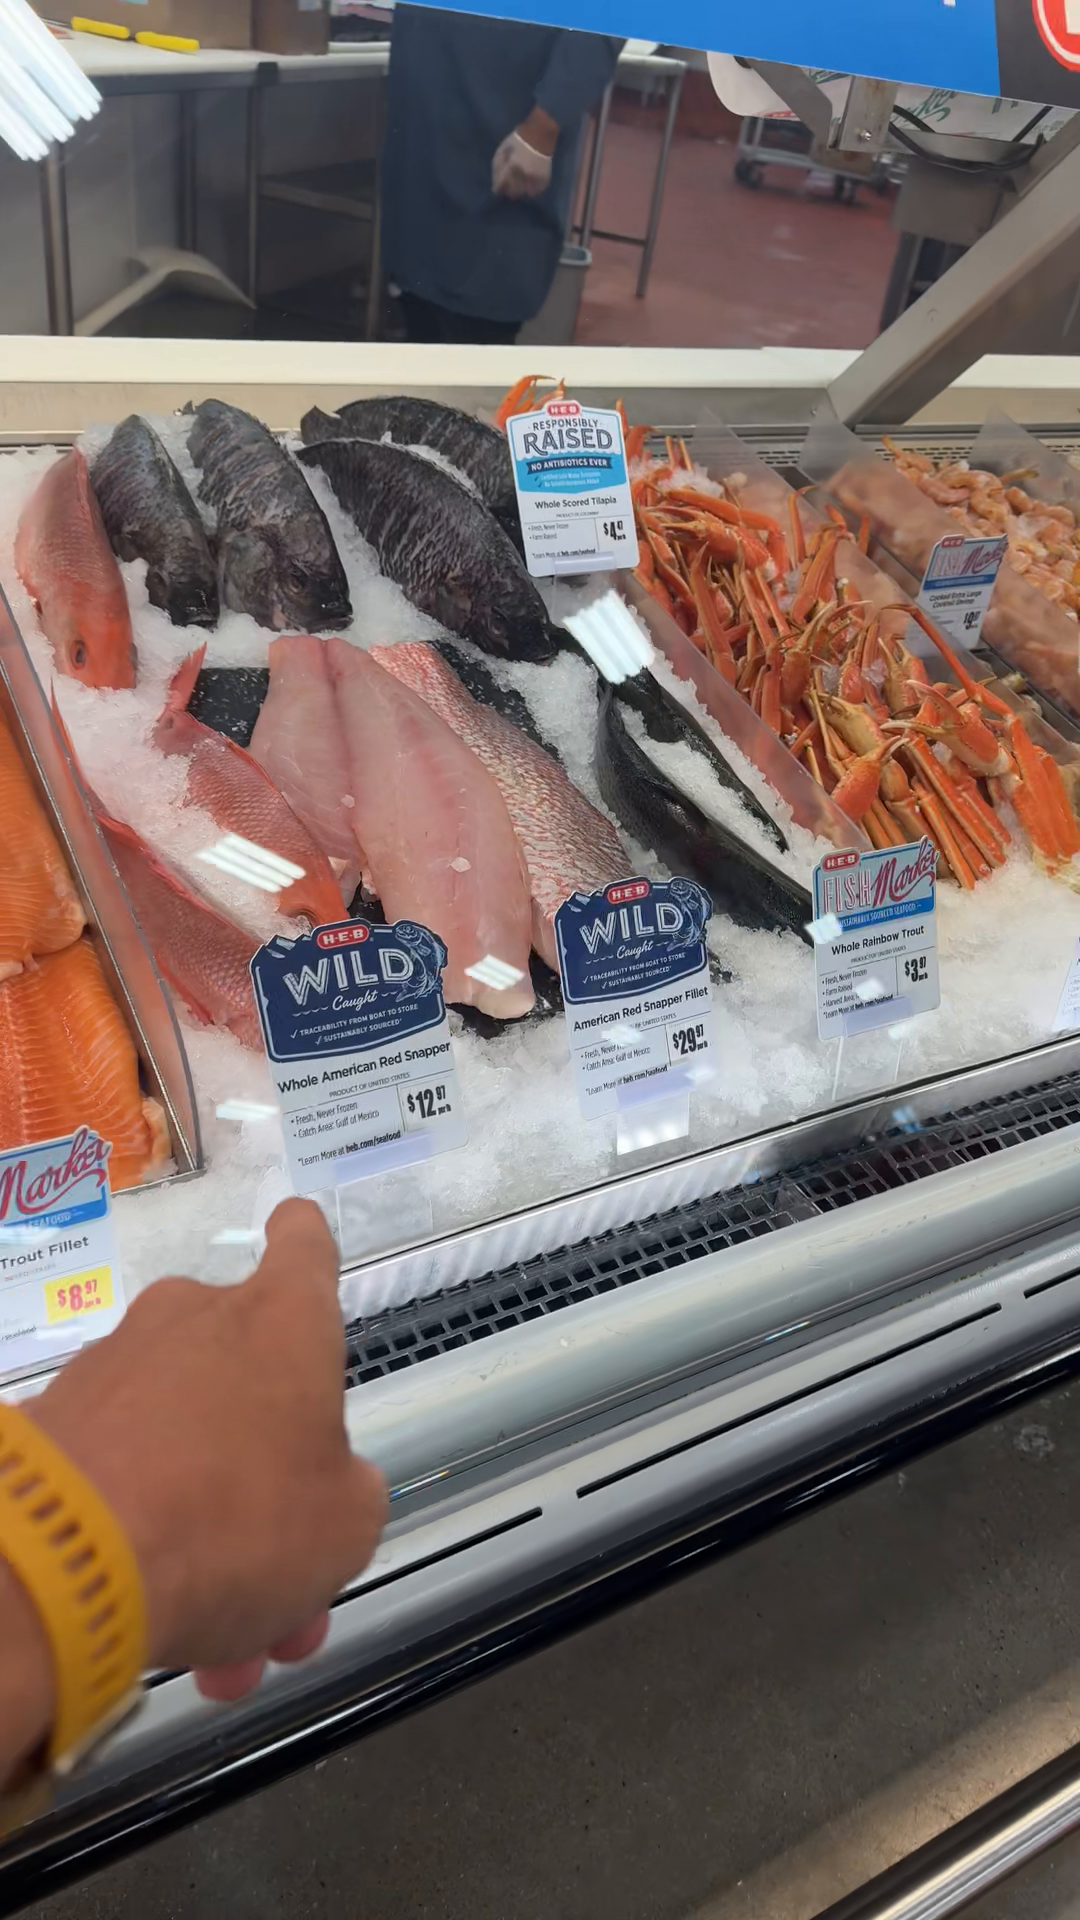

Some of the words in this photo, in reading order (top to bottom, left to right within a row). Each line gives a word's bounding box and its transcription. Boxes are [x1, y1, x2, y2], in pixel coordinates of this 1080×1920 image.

[533, 419, 598, 431] RESPONSIBLY
[524, 428, 612, 456] RAISED
[531, 463, 542, 471] NO
[543, 458, 588, 469] ANTIBIOTICS
[589, 458, 608, 466] EVER
[535, 500, 560, 509] Whole
[562, 498, 590, 507] Scored
[591, 496, 617, 505] Tilapia
[824, 870, 871, 914] FISH
[871, 839, 938, 908] Market
[579, 903, 684, 954] WILD
[832, 942, 860, 955] Whole
[862, 932, 899, 948] Rainbow
[902, 926, 924, 938] Trout
[616, 941, 654, 960] Caught
[282, 948, 414, 1006] WILD
[589, 967, 628, 982] TRACEABILITY
[629, 963, 645, 972] FROM
[646, 960, 659, 968] BOAT
[668, 952, 686, 962] STORE
[826, 977, 839, 985] Fresh,
[839, 973, 852, 982] Never
[853, 969, 867, 978] Frozen
[608, 973, 644, 987] SUSTAINABLY
[826, 988, 837, 996] Farm
[838, 983, 853, 992] Raised
[332, 990, 379, 1011] Caught
[574, 1012, 620, 1032] American
[622, 1004, 642, 1019] Red
[644, 994, 682, 1012] Snapper
[685, 986, 708, 1001] Fillet
[826, 997, 843, 1007] Harvest
[300, 1020, 347, 1036] TRACEABILITY
[349, 1015, 368, 1026] FROM
[369, 1010, 386, 1021] BOAT
[388, 1008, 396, 1017] TO
[398, 1003, 418, 1015] STORE
[660, 1012, 676, 1022] STATES
[323, 1026, 368, 1043] SUSTAINABLY
[586, 1061, 601, 1072] Catch
[615, 1052, 626, 1063] Gulf
[633, 1047, 651, 1058] Mexico
[601, 1045, 616, 1054] Never
[278, 1074, 318, 1093] Whole
[321, 1060, 377, 1083] American
[379, 1053, 402, 1069] Red
[404, 1042, 451, 1062] Snapper
[329, 1085, 358, 1098] PRODUCT
[368, 1077, 389, 1089] UNITED
[390, 1072, 410, 1082] STATES
[603, 1079, 616, 1091] More
[296, 1112, 316, 1125] Fresh,
[316, 1108, 335, 1119] Never
[336, 1102, 358, 1114] Frozen
[298, 1126, 316, 1138] Catch
[335, 1117, 349, 1129] Gulf
[350, 1116, 356, 1124] of
[357, 1110, 380, 1122] Mexico
[320, 1148, 337, 1160] More
[338, 1147, 345, 1156] at
[345, 1130, 401, 1154] heb.com/seafood
[0, 1128, 111, 1219] Market
[0, 1250, 44, 1270] Trout
[49, 1236, 89, 1256] Fillet
